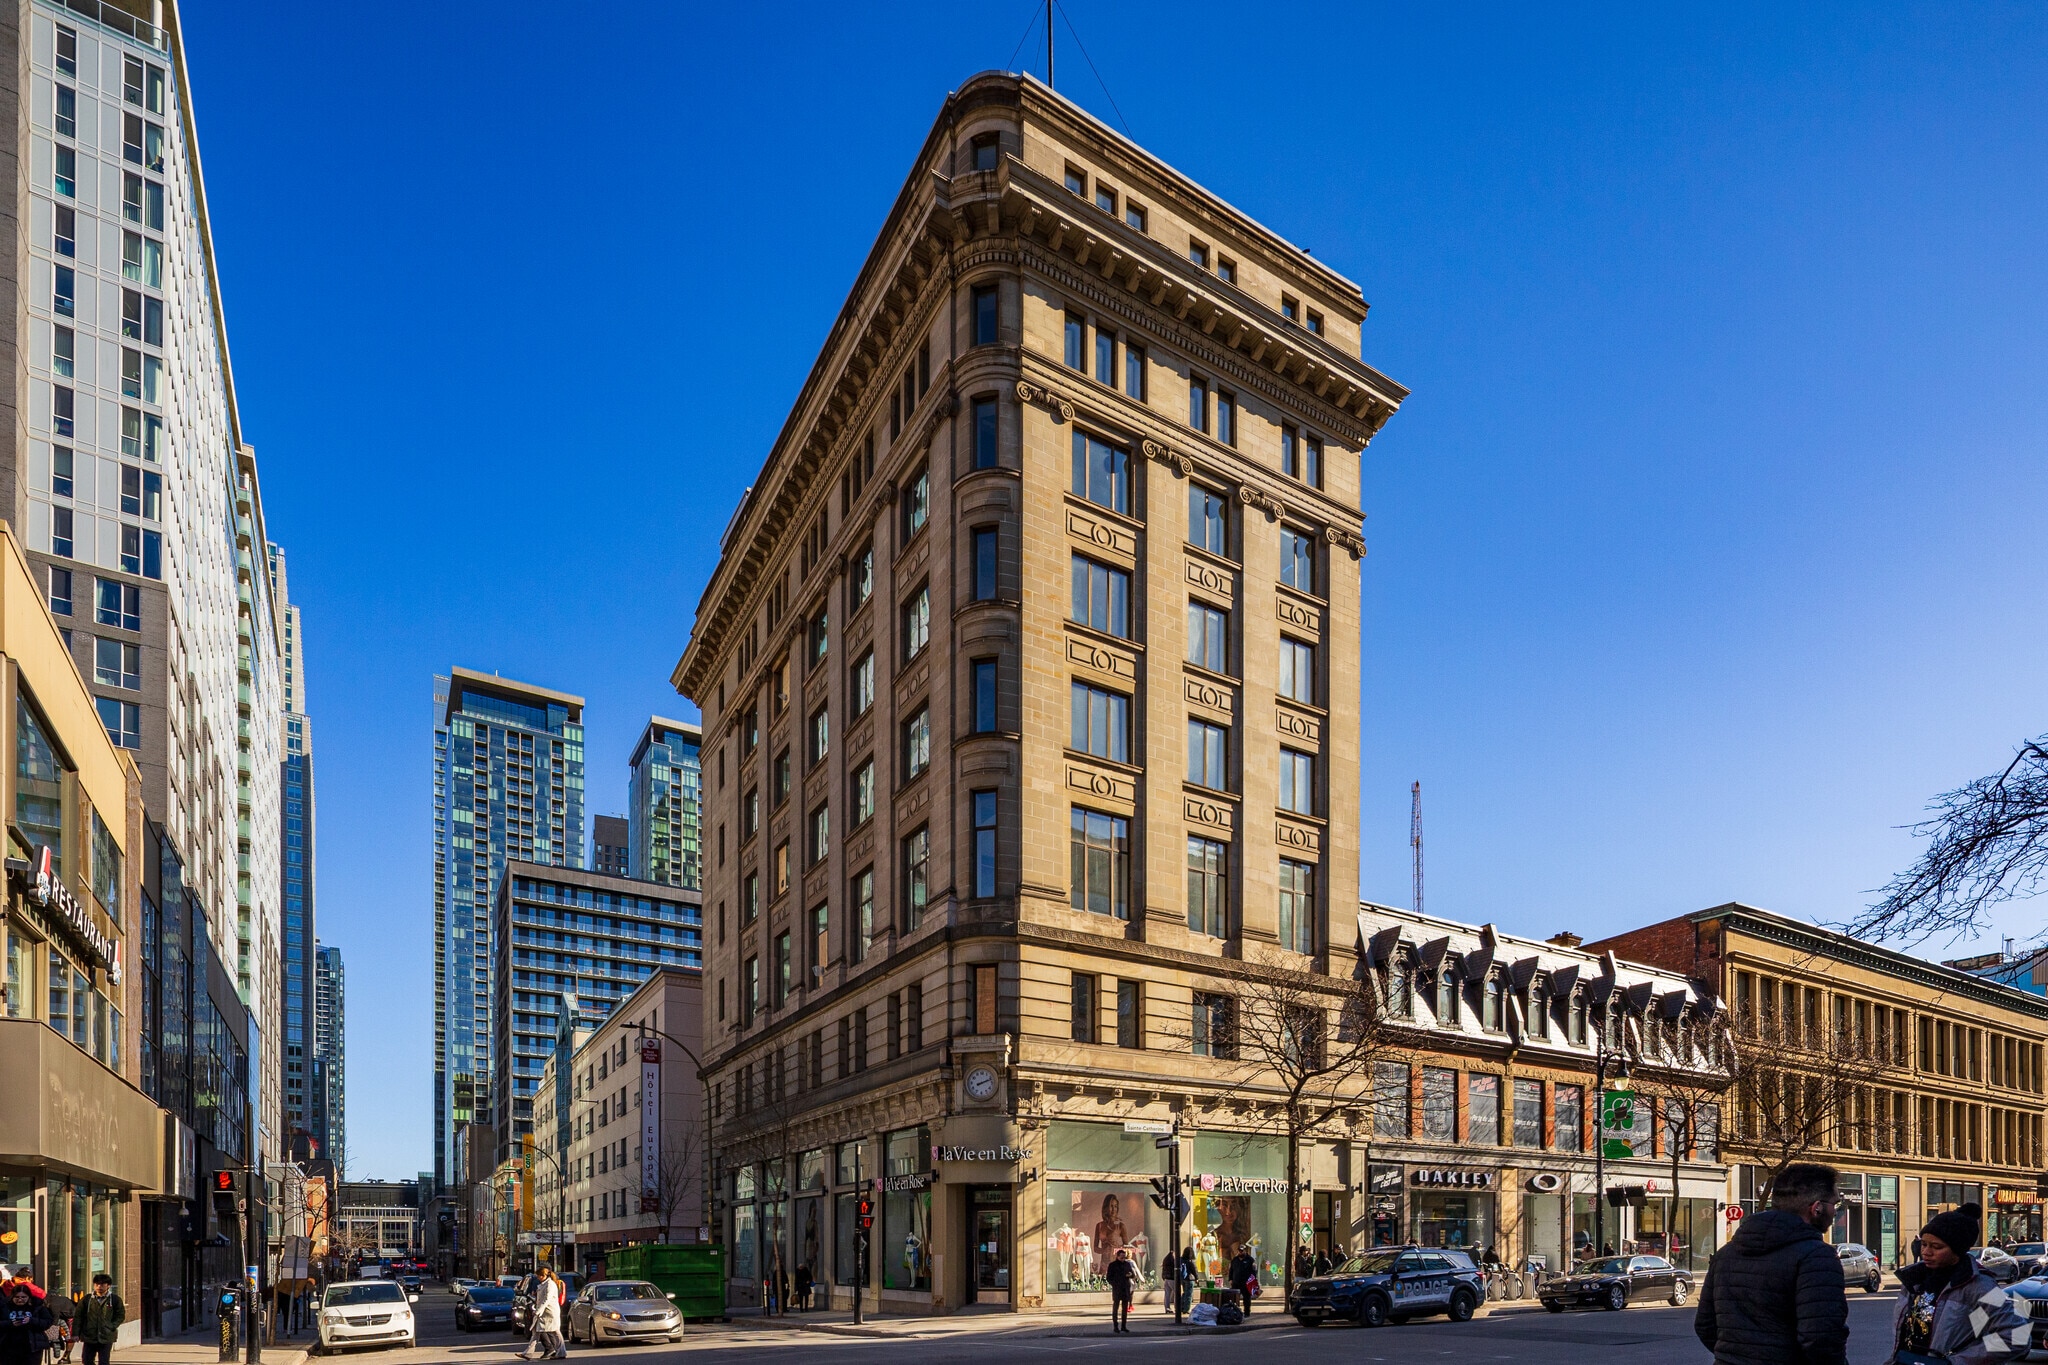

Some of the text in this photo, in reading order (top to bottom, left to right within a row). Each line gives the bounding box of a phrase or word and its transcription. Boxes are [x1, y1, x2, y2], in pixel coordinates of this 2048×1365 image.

[52, 876, 112, 963] RESTAURANT
[978, 1149, 995, 1160] en
[1000, 1145, 1033, 1160] Rose
[900, 1179, 908, 1190] en
[909, 1174, 925, 1189] Rose
[1418, 1169, 1493, 1185] OAKLEY
[1252, 1182, 1268, 1193] en
[1997, 1189, 2017, 1203] URBAN
[1404, 1280, 1450, 1297] POLICE
